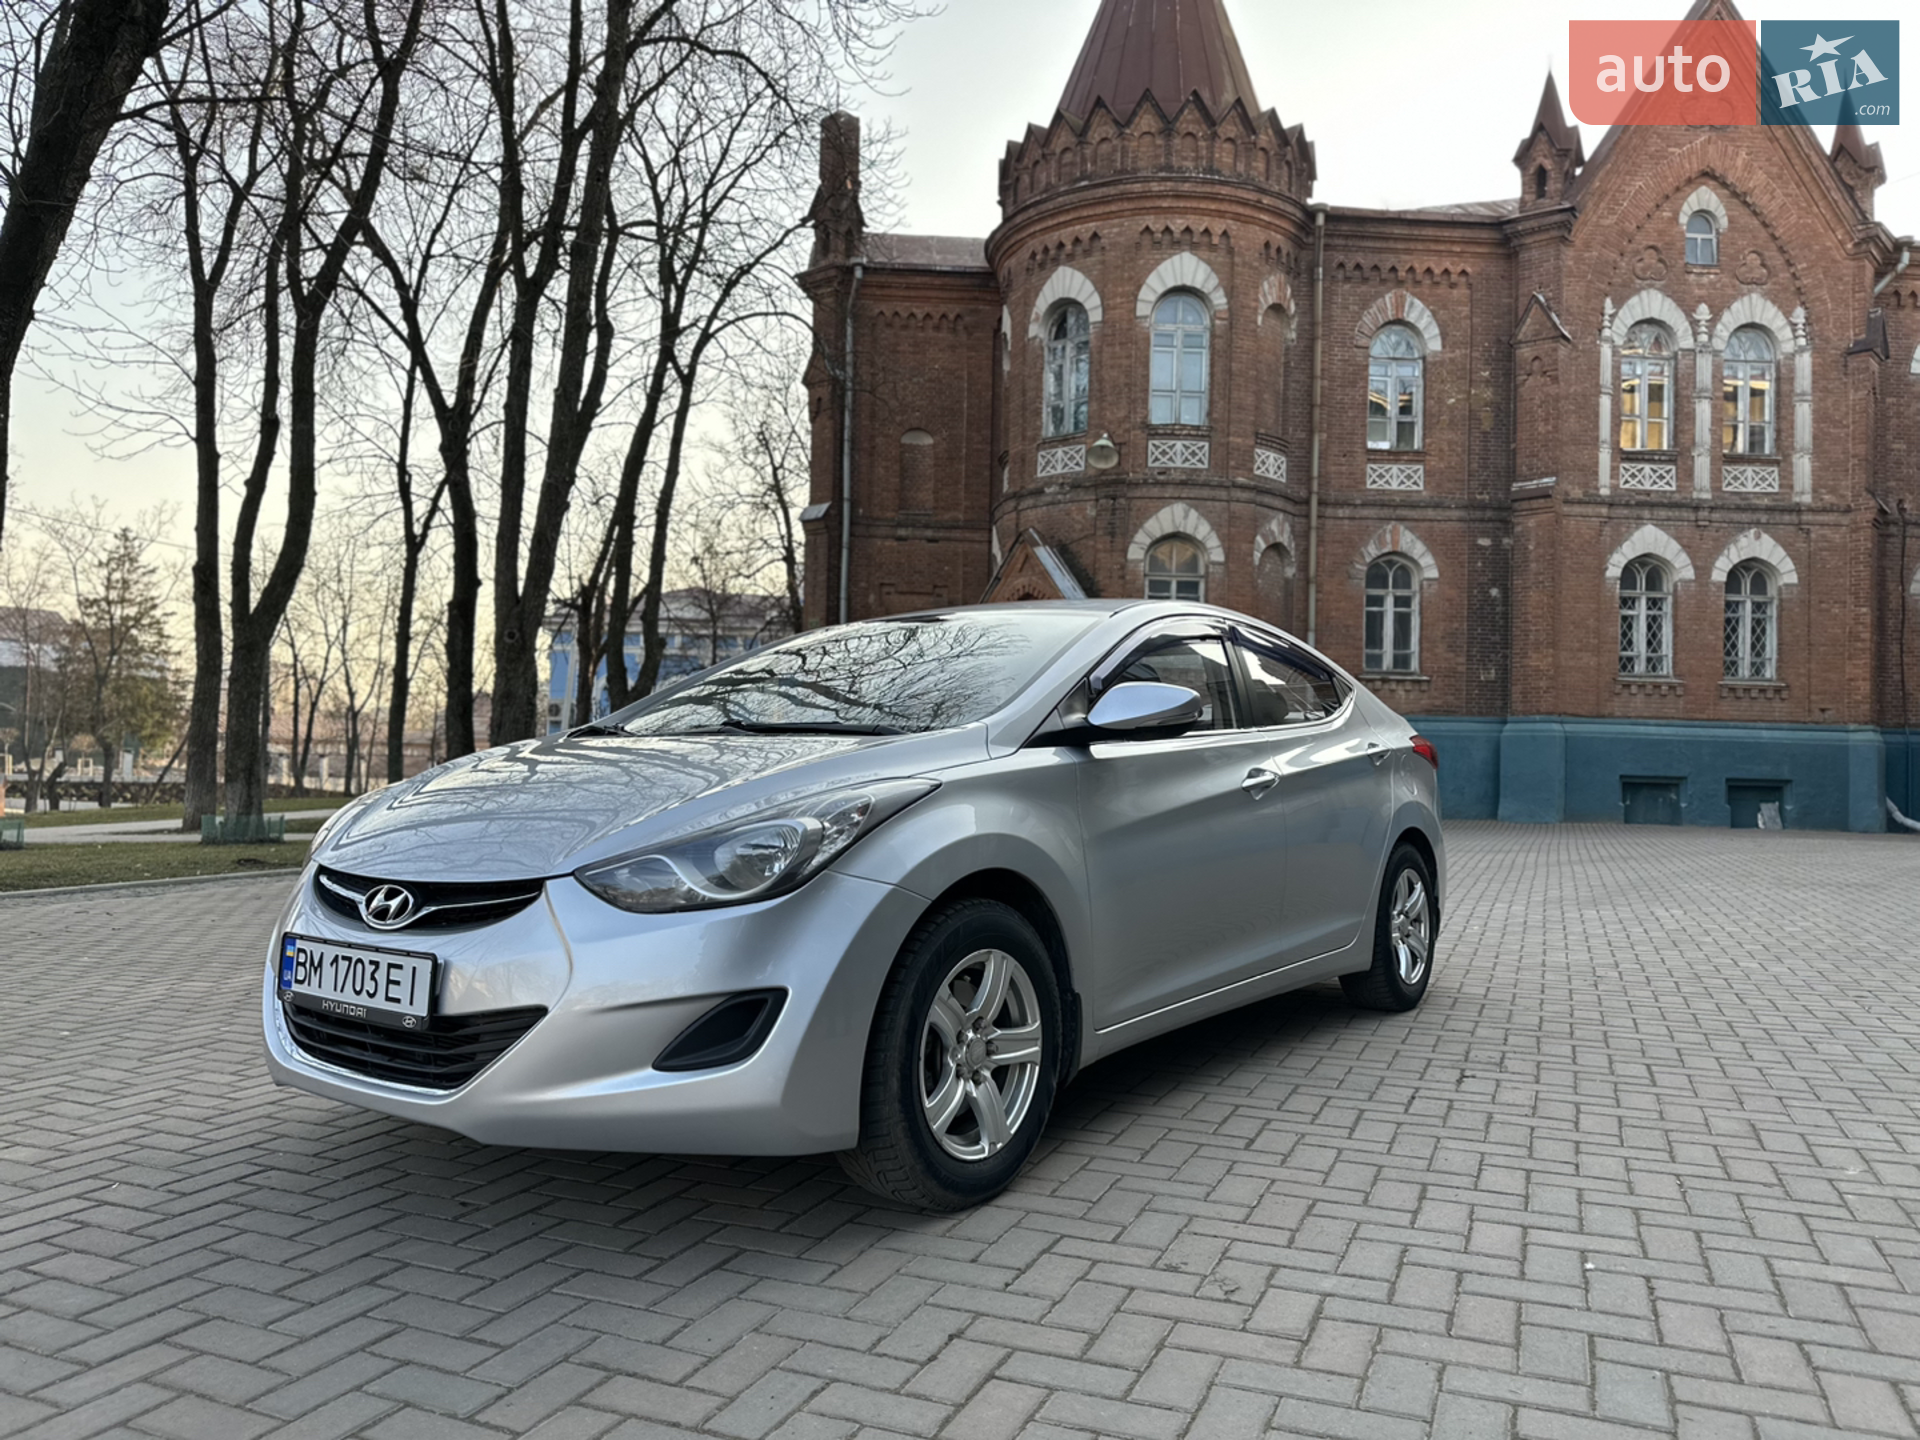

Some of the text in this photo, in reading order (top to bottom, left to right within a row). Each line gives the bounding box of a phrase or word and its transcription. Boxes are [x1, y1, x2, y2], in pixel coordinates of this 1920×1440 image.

[294, 947, 417, 1006] BM 1703 EI
[321, 999, 368, 1019] HYUNDAI
